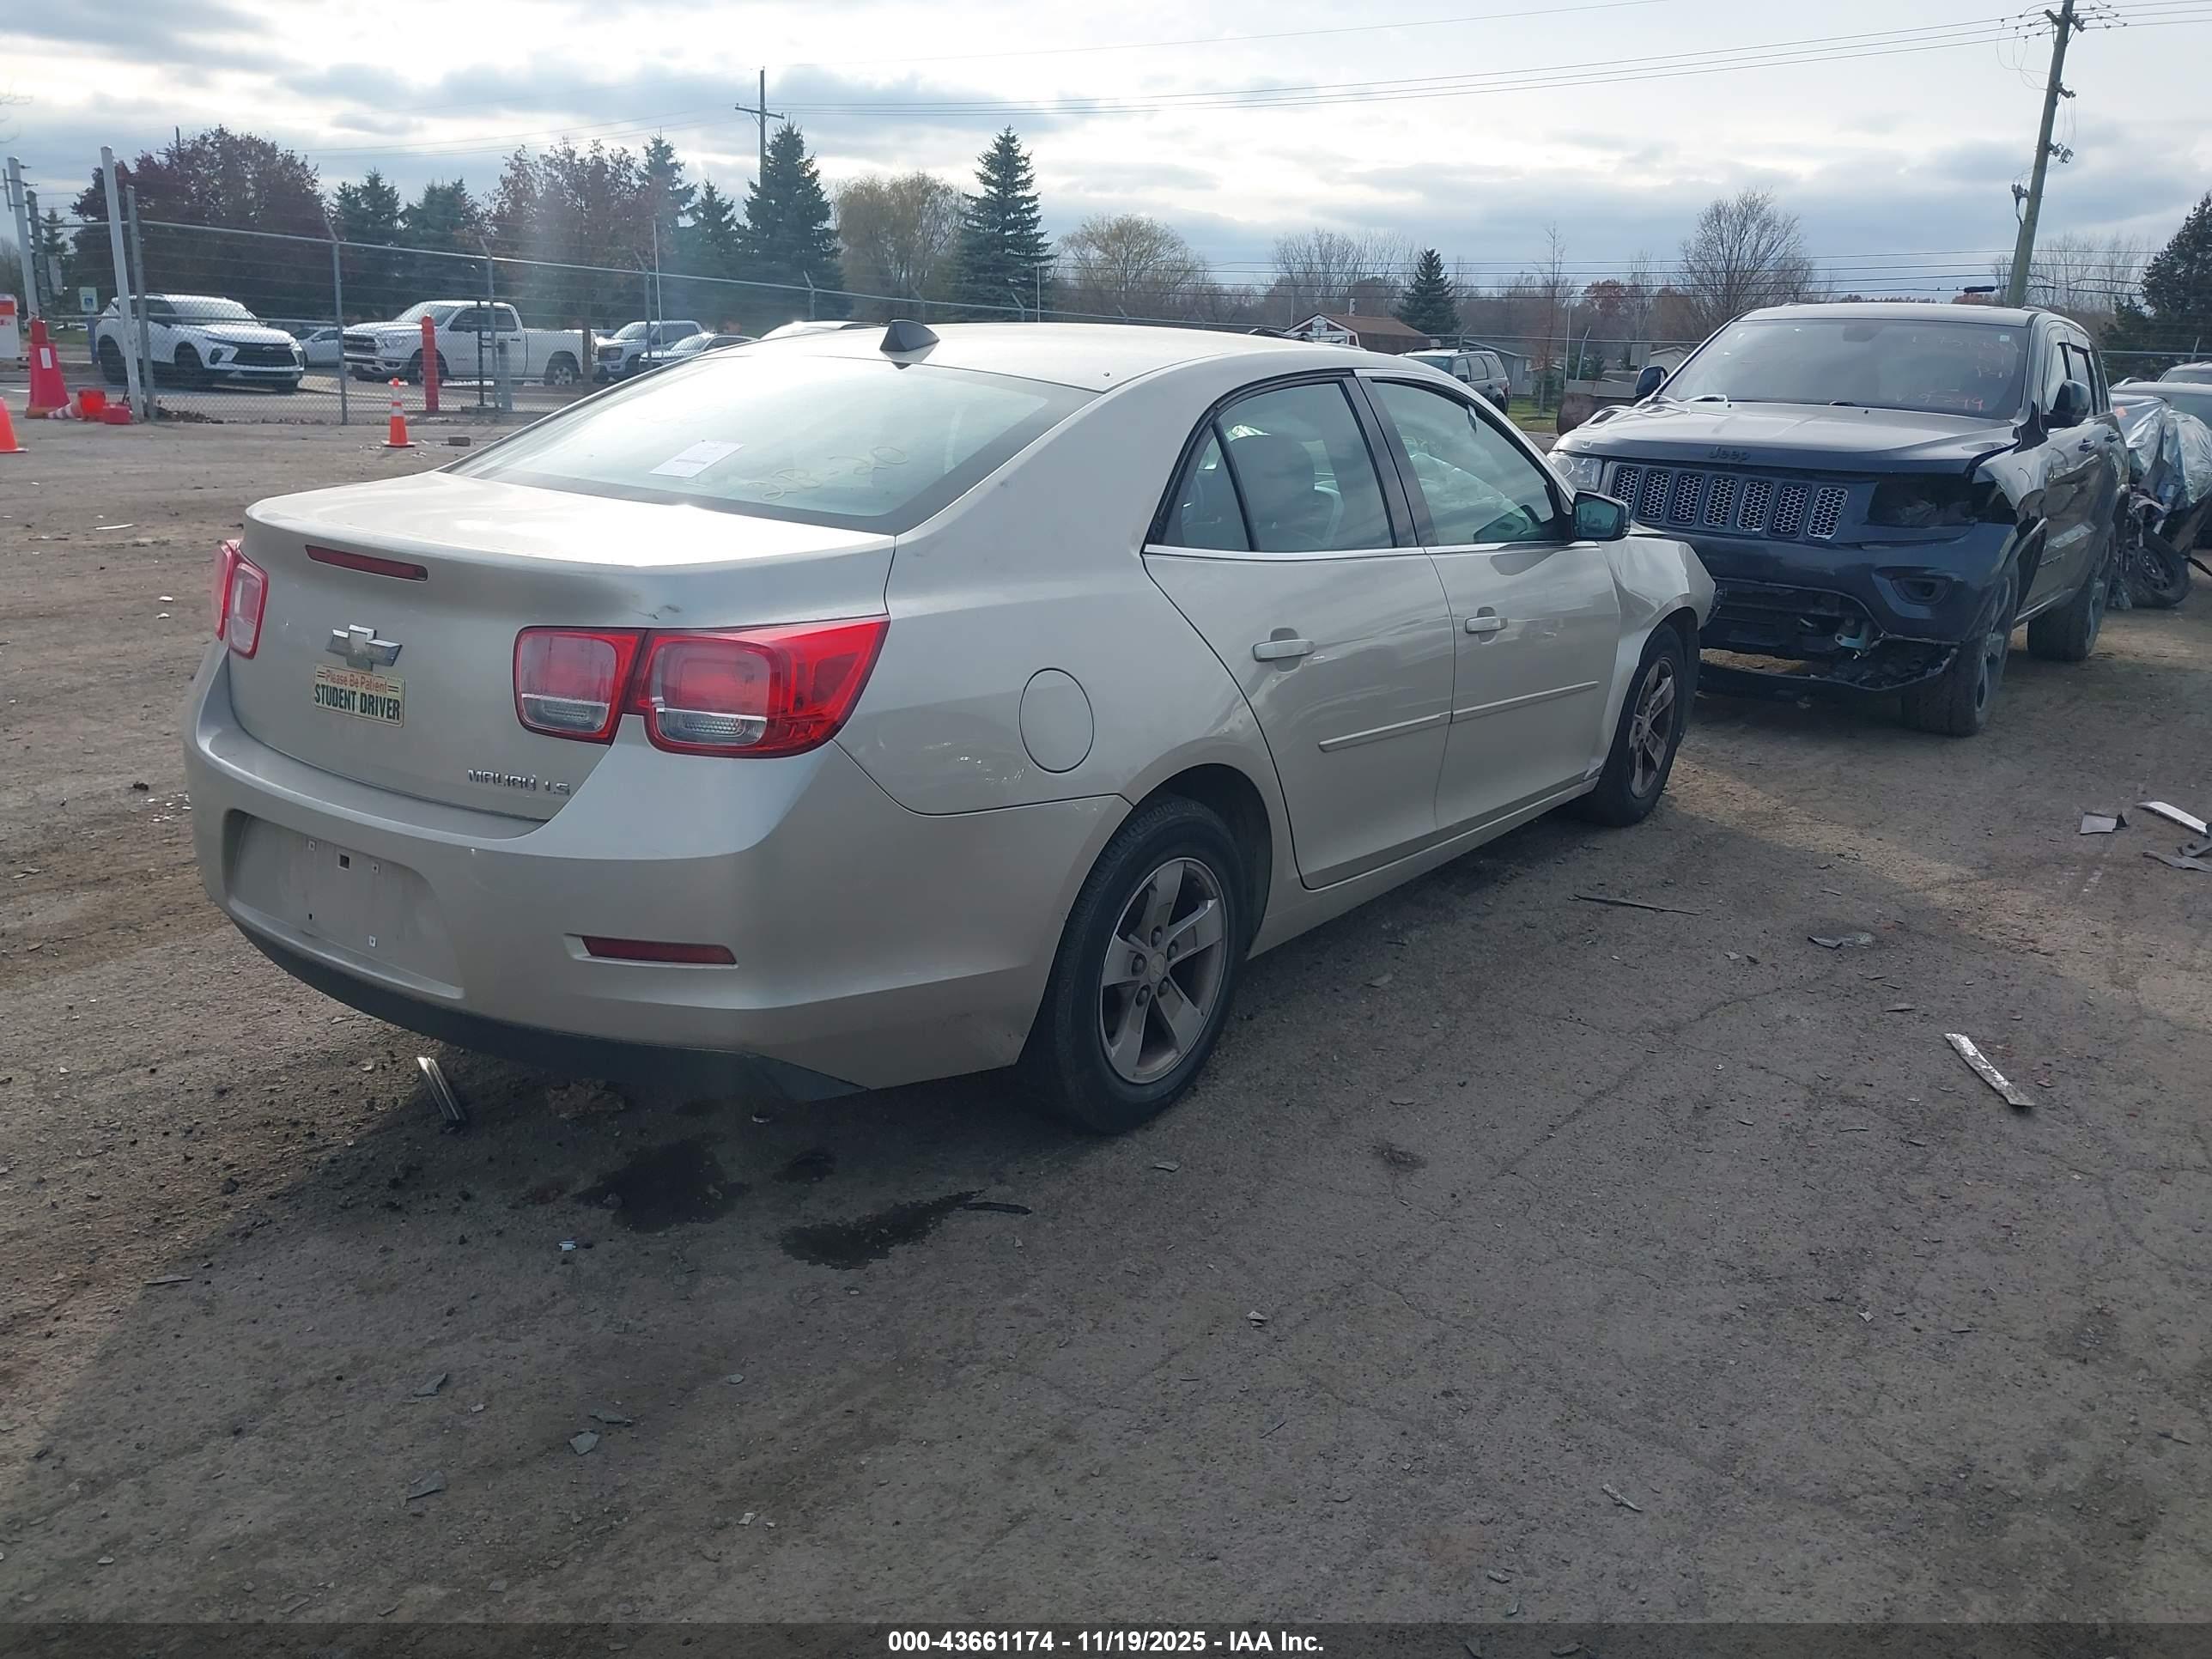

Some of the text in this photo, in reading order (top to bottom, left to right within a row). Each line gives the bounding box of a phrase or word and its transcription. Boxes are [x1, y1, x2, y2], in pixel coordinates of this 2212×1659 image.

[1710, 446, 1751, 463] Jeep
[325, 670, 387, 694] Please Be Patient
[314, 684, 401, 720] STUDENT DRIVER
[467, 769, 537, 791] MALIBU
